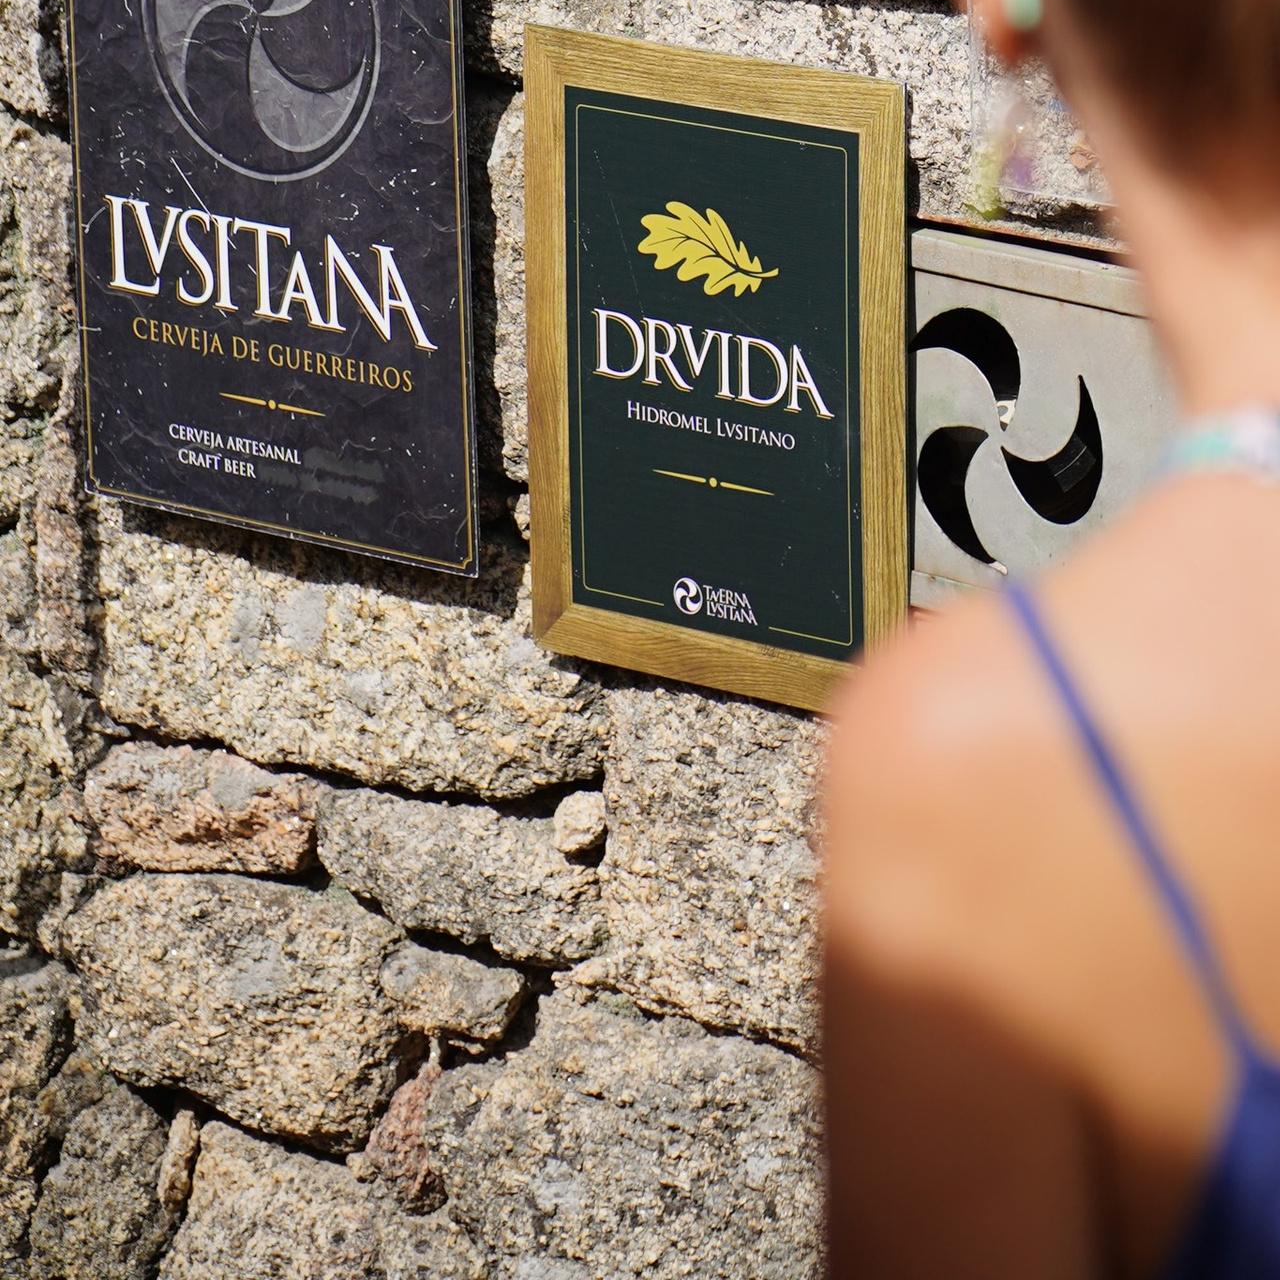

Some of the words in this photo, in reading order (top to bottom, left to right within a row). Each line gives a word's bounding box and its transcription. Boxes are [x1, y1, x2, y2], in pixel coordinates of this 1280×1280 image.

[103, 194, 438, 352] LVSITANA
[132, 317, 224, 357] CERVEJA
[232, 335, 260, 363] DE
[267, 342, 414, 393] GUERREIROS
[591, 308, 835, 419] DRVIDA
[168, 423, 223, 449] CERVEJA
[226, 436, 302, 465] ARTESANAL
[177, 448, 220, 471] CRAFT
[223, 458, 257, 479] BEER
